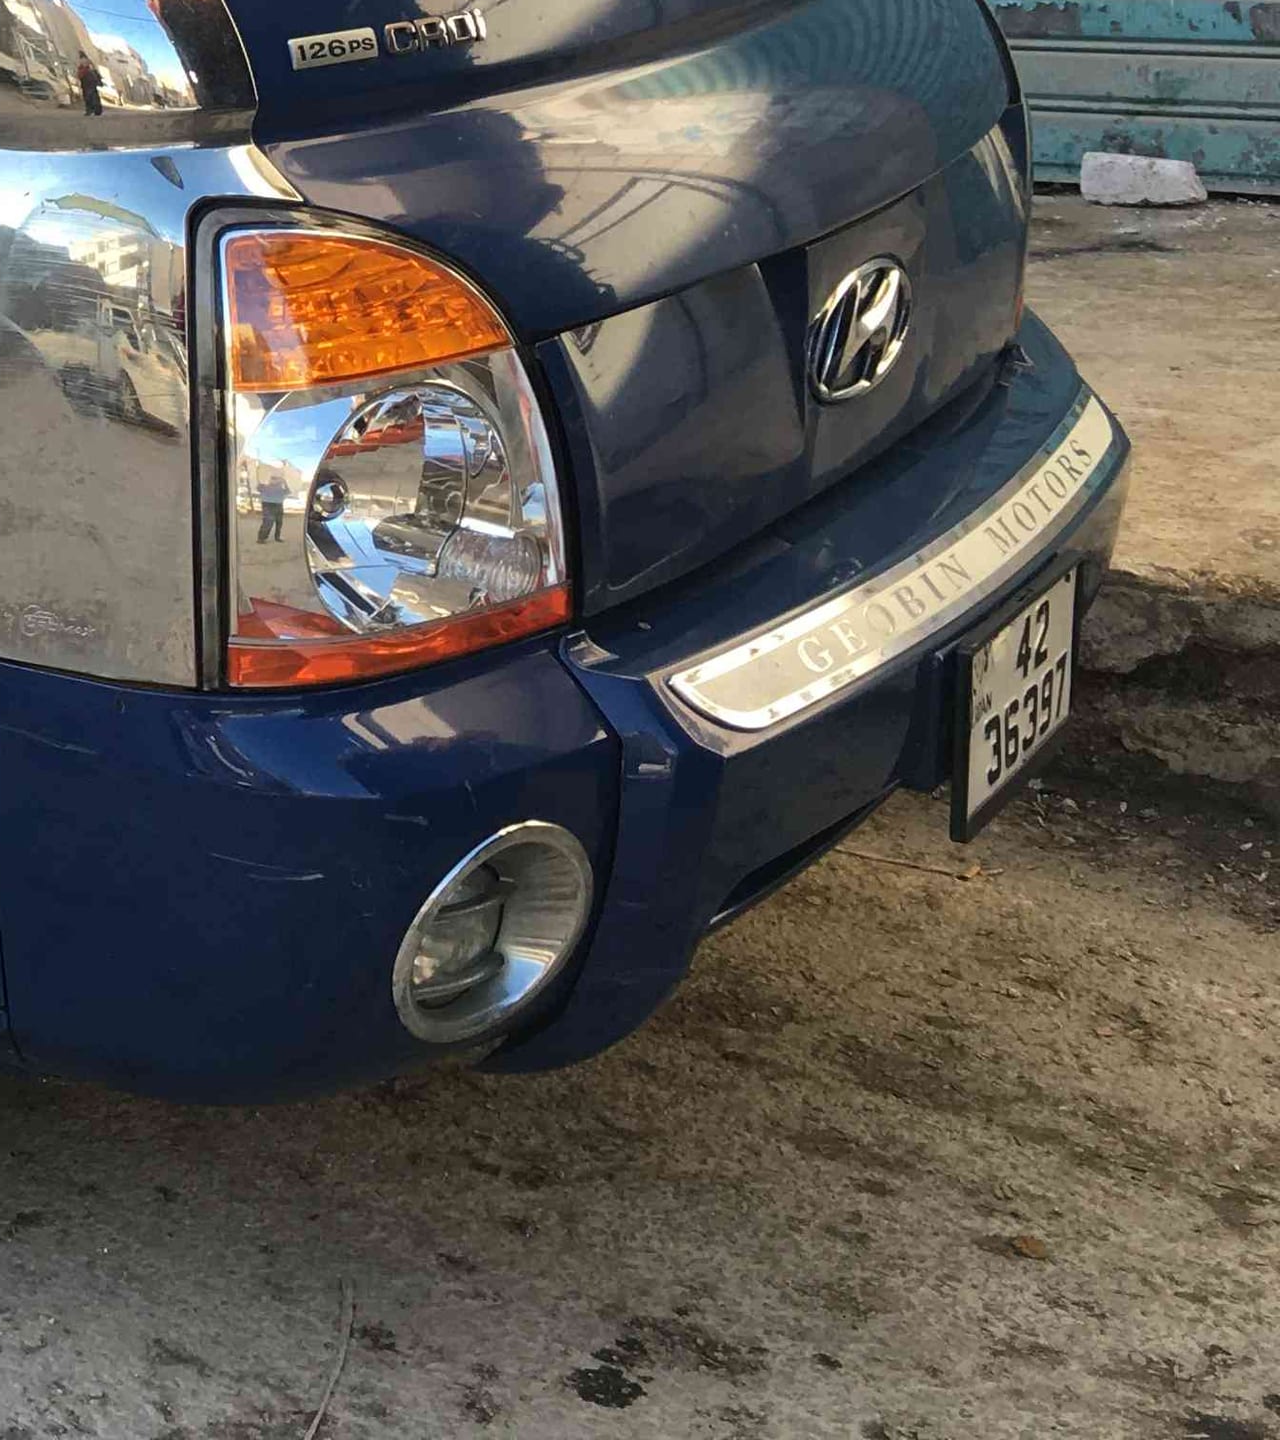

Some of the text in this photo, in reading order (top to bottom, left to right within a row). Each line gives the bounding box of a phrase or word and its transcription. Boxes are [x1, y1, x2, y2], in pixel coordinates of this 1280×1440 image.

[384, 8, 488, 54] CRDi
[797, 439, 1092, 673] GEOBIN MOTORS
[1016, 600, 1050, 679] 42
[984, 651, 1068, 786] 36397
